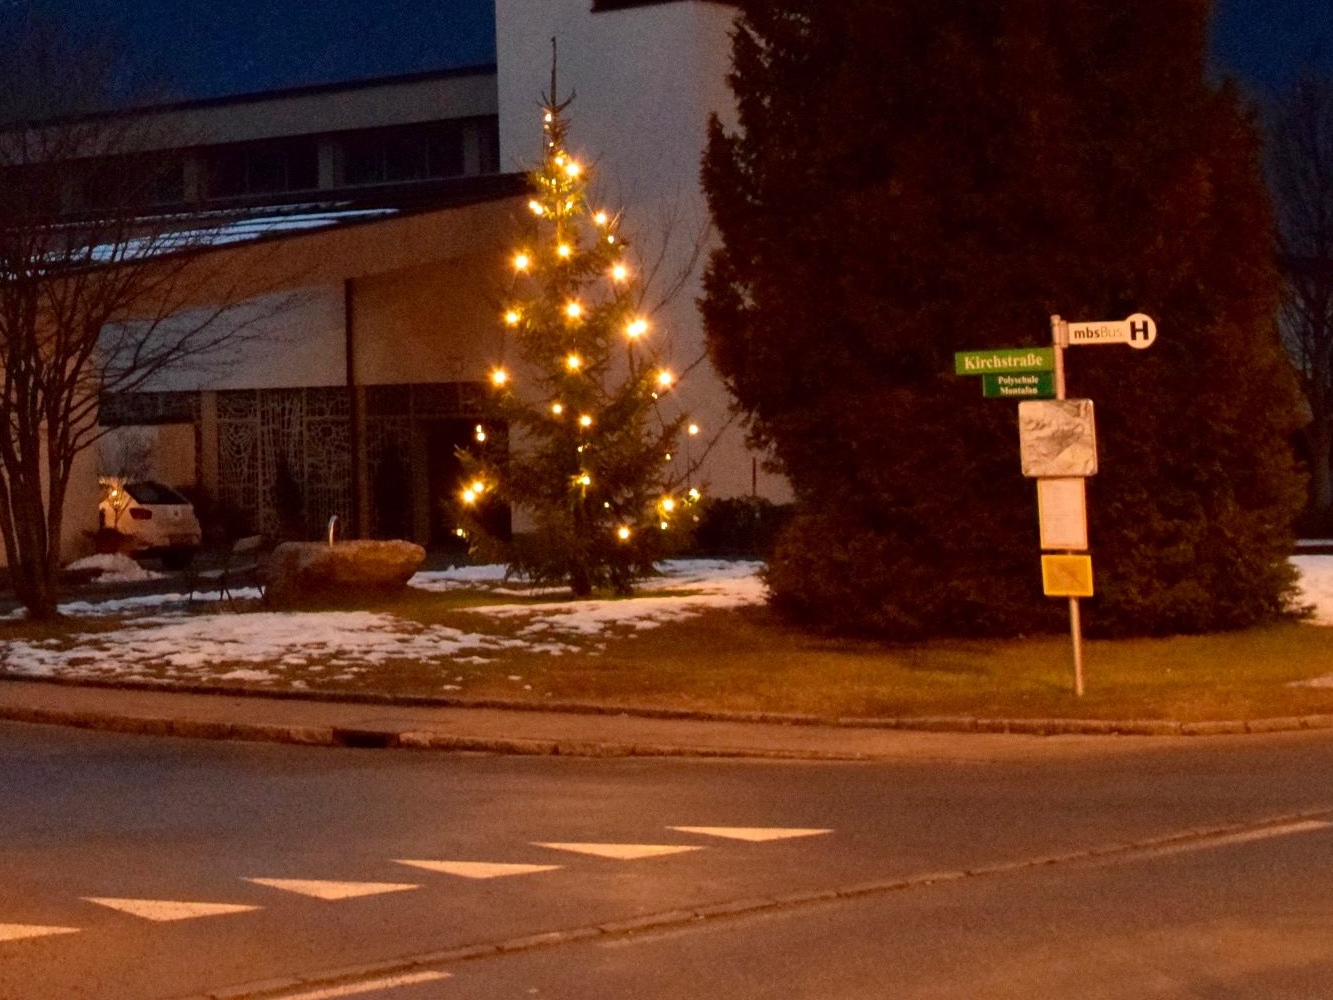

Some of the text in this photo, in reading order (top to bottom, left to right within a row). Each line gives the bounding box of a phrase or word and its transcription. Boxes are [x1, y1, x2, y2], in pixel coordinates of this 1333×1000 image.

[1130, 320, 1149, 341] H
[964, 353, 1043, 370] Kirchstraße
[998, 375, 1039, 386] Polyschule
[1000, 386, 1038, 395] Montafon
